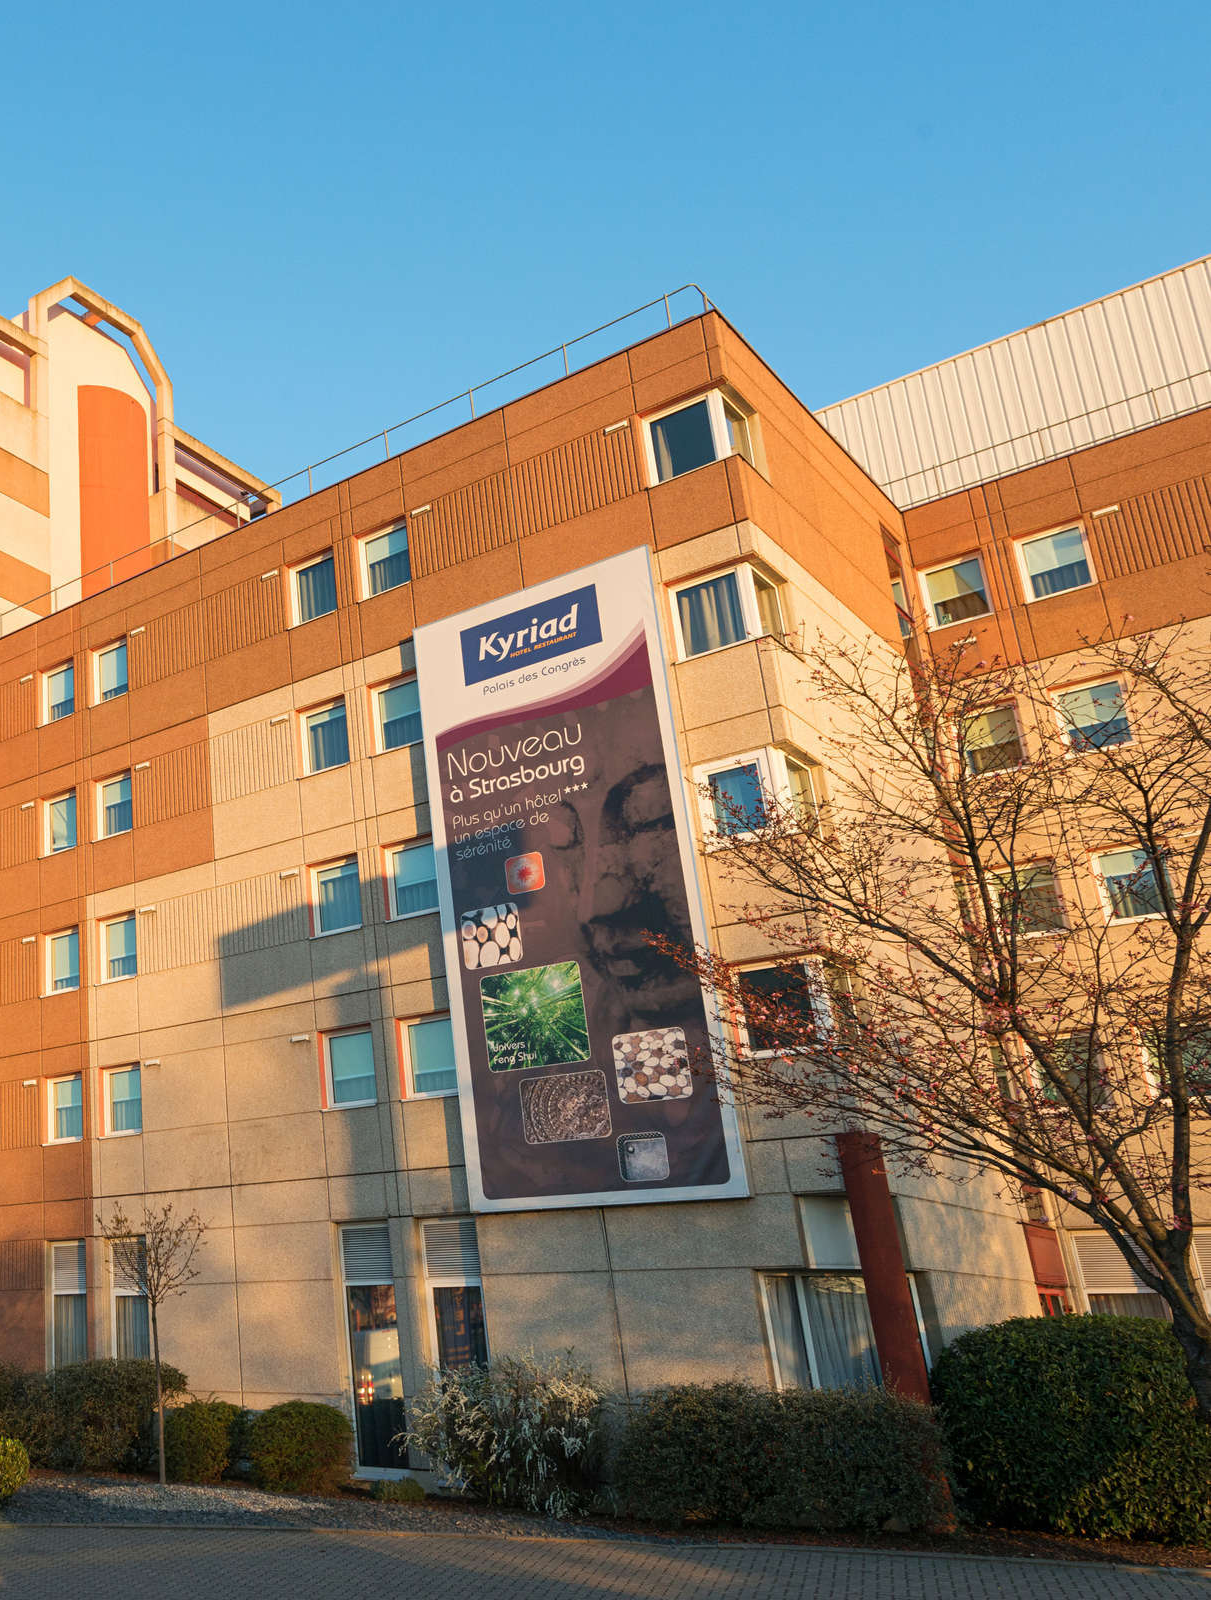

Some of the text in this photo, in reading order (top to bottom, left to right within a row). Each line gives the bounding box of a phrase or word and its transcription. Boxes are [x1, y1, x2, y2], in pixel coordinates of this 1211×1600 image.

[478, 603, 579, 663] Kyriad
[509, 631, 577, 659] HOTEL RESTAURANT
[482, 655, 586, 695] Palais des Congrès
[447, 723, 582, 780] Nouveau
[450, 755, 585, 803] à Strasbourg
[452, 789, 563, 829] Plus qu'un hôtel
[454, 811, 550, 845] un espace de
[455, 837, 512, 861] sérénité
[493, 1041, 526, 1053] Univers
[493, 1055, 516, 1065] Feng
